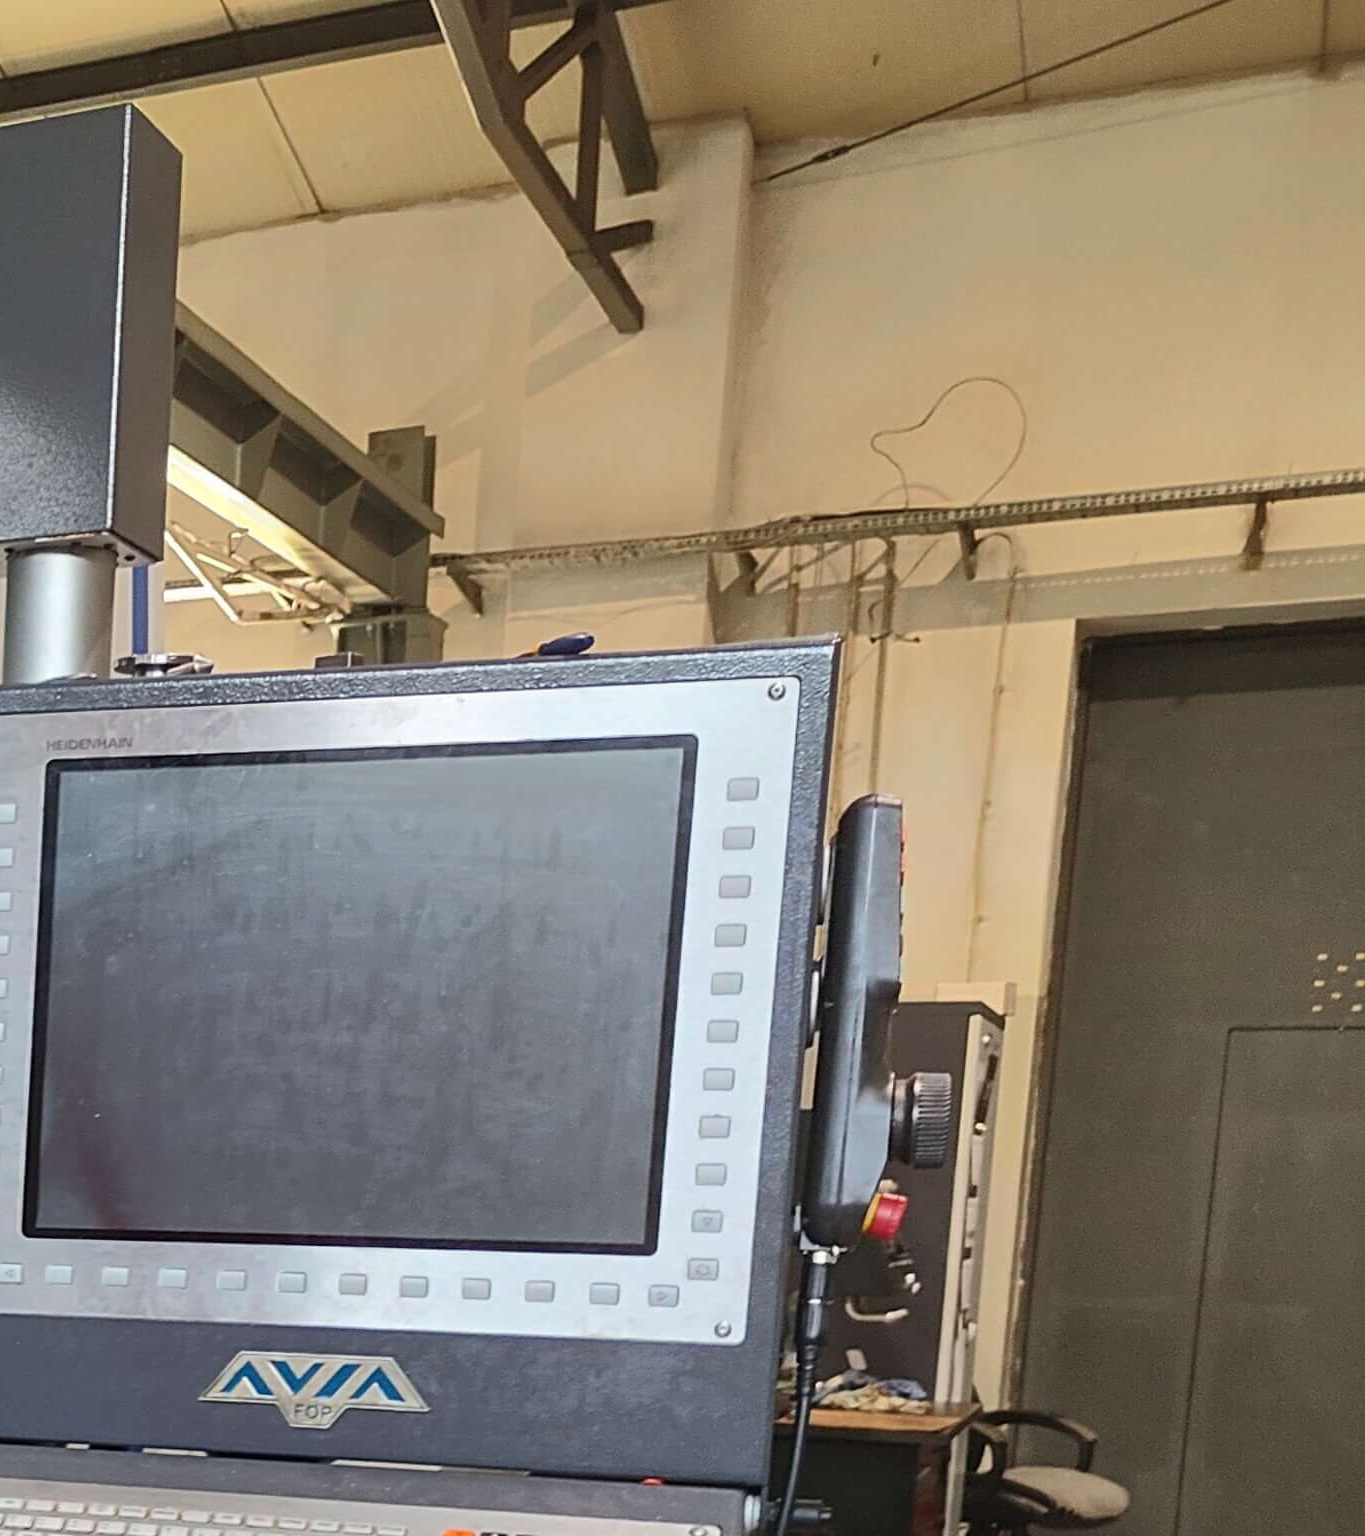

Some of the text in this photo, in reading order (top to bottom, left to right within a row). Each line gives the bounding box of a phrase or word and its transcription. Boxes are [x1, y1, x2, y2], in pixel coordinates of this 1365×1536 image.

[45, 737, 133, 751] HEIDENHAIN
[220, 1359, 406, 1402] AVIA
[292, 1402, 333, 1420] FOP
